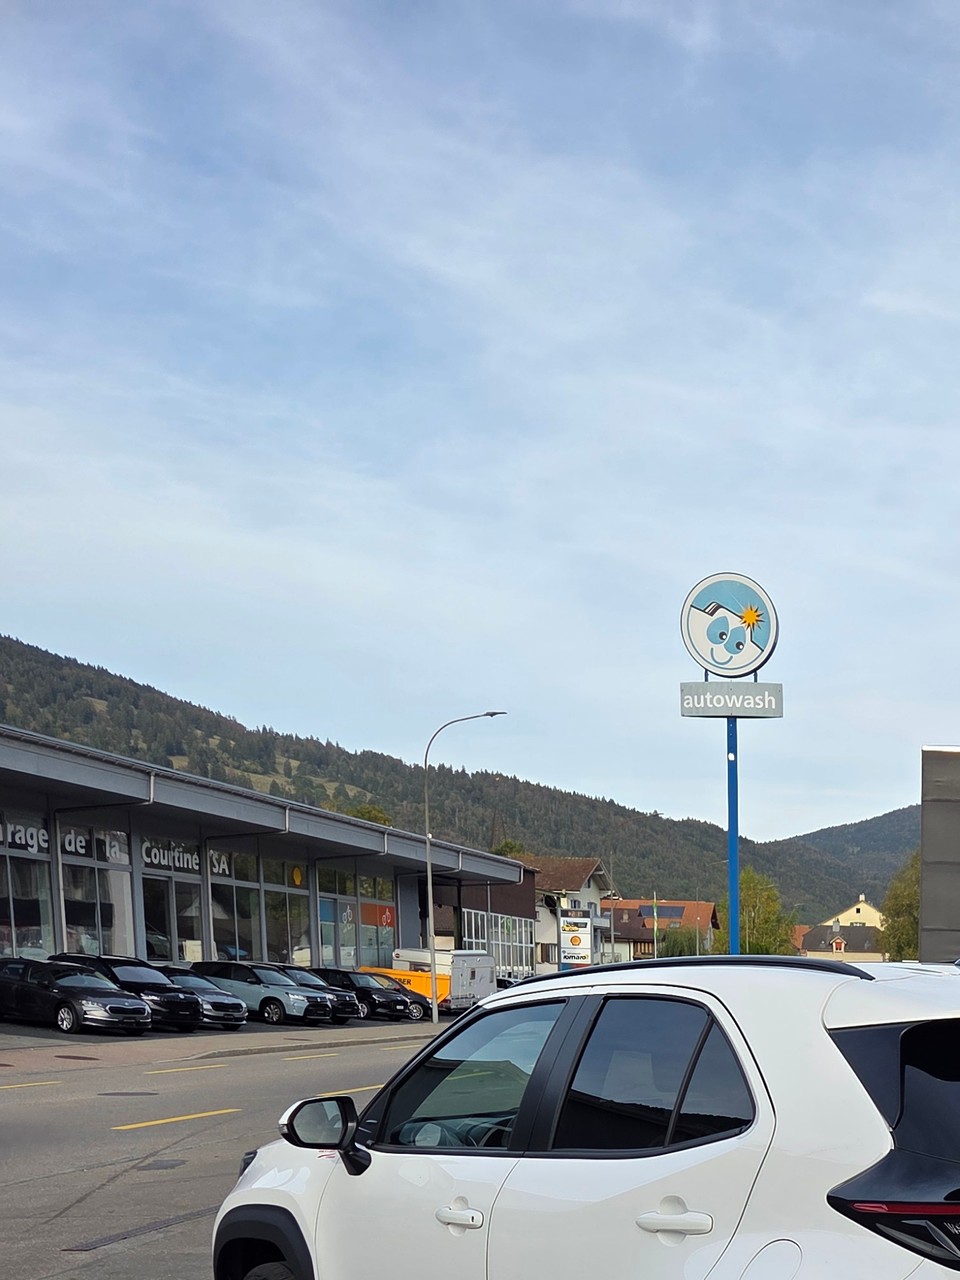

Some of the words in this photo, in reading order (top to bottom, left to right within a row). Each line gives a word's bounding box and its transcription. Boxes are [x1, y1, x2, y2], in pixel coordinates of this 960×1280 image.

[683, 691, 776, 709] autowash
[0, 823, 49, 854] rage
[64, 829, 86, 854] de
[106, 834, 120, 859] la
[141, 841, 199, 870] Courtine
[212, 855, 229, 875] SA
